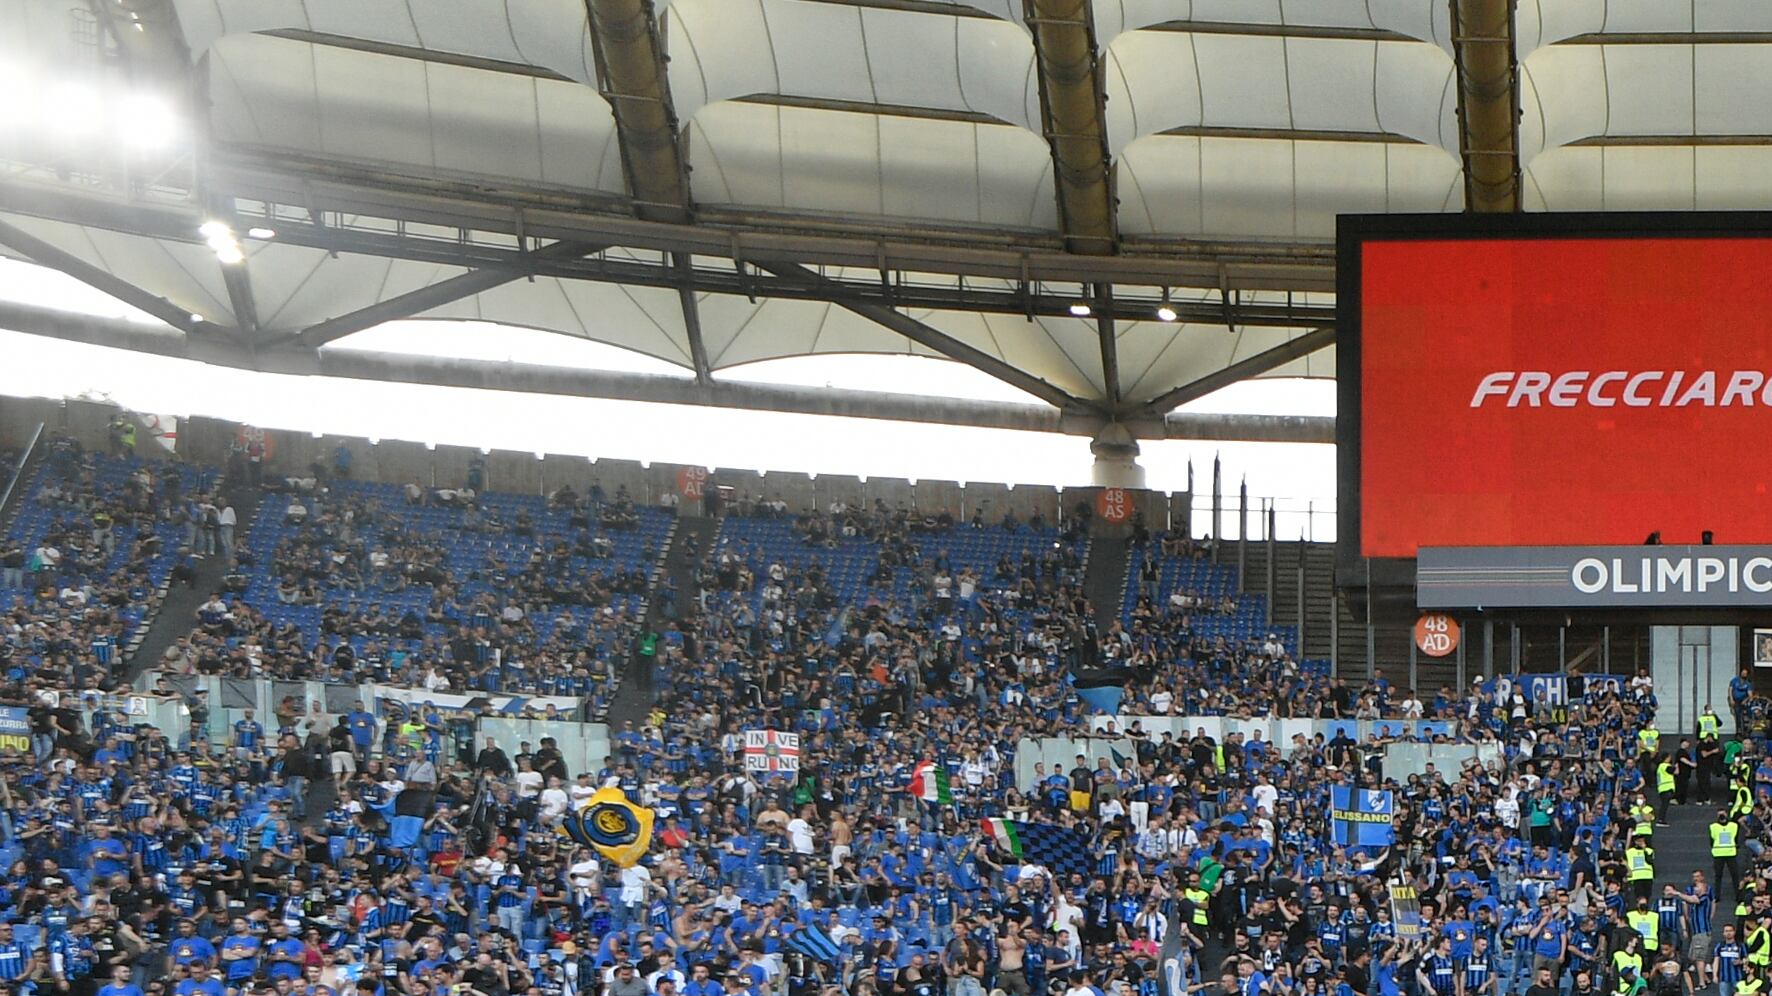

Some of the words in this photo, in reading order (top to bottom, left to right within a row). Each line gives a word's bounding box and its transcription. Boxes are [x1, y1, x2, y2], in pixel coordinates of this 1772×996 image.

[1105, 490, 1124, 504] 48
[1104, 504, 1125, 518] AS
[1424, 615, 1448, 632] 48
[1422, 633, 1450, 651] AD
[750, 733, 764, 745] IN
[778, 734, 798, 748] VE
[748, 756, 767, 769] RU
